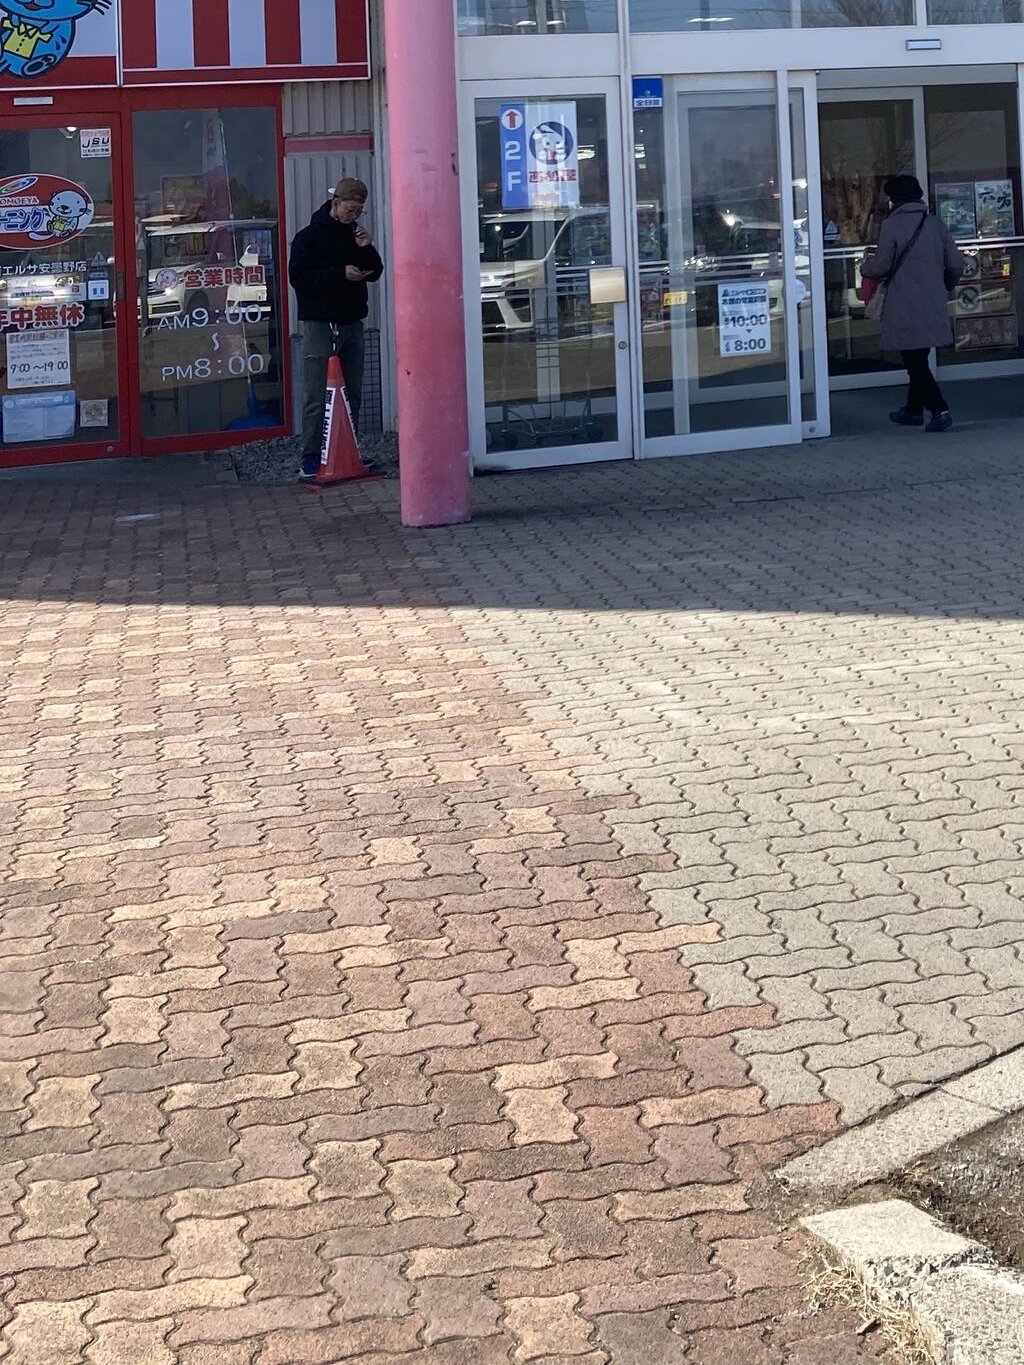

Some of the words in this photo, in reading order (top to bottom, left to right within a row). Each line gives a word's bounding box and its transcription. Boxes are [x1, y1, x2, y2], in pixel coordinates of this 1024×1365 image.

[82, 137, 110, 148] JSU
[0, 260, 88, 277] エルサ安曇野店
[183, 265, 265, 289] 営業時間
[732, 314, 768, 328] 10:00
[734, 338, 767, 352] 8:00
